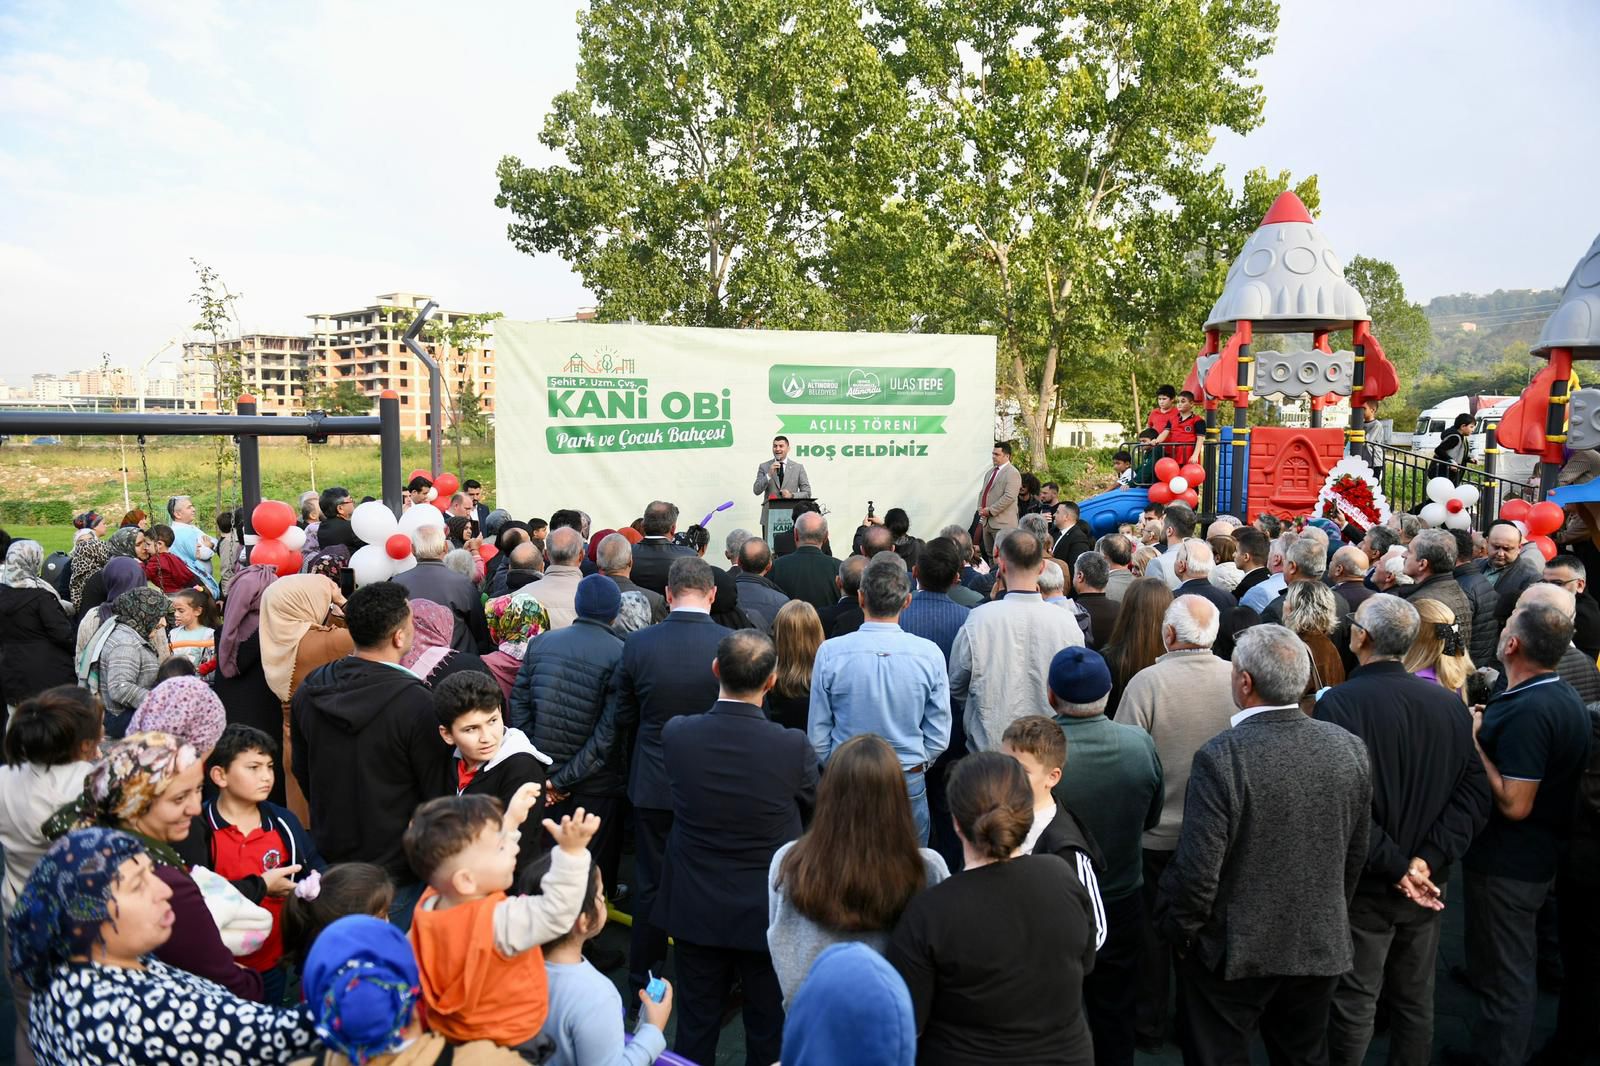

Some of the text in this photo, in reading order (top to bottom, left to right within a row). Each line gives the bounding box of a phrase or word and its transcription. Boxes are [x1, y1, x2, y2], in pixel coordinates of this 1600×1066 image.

[550, 377, 638, 389] Şehit P. Uzm. Çvş.
[890, 377, 944, 391] ULAŞ TEPE
[809, 416, 917, 433] AÇILIŞ TÖRENİ
[556, 425, 727, 450] Park ve Çocuk Bahçesi
[796, 439, 929, 461] HOŞ GELDİNİZ
